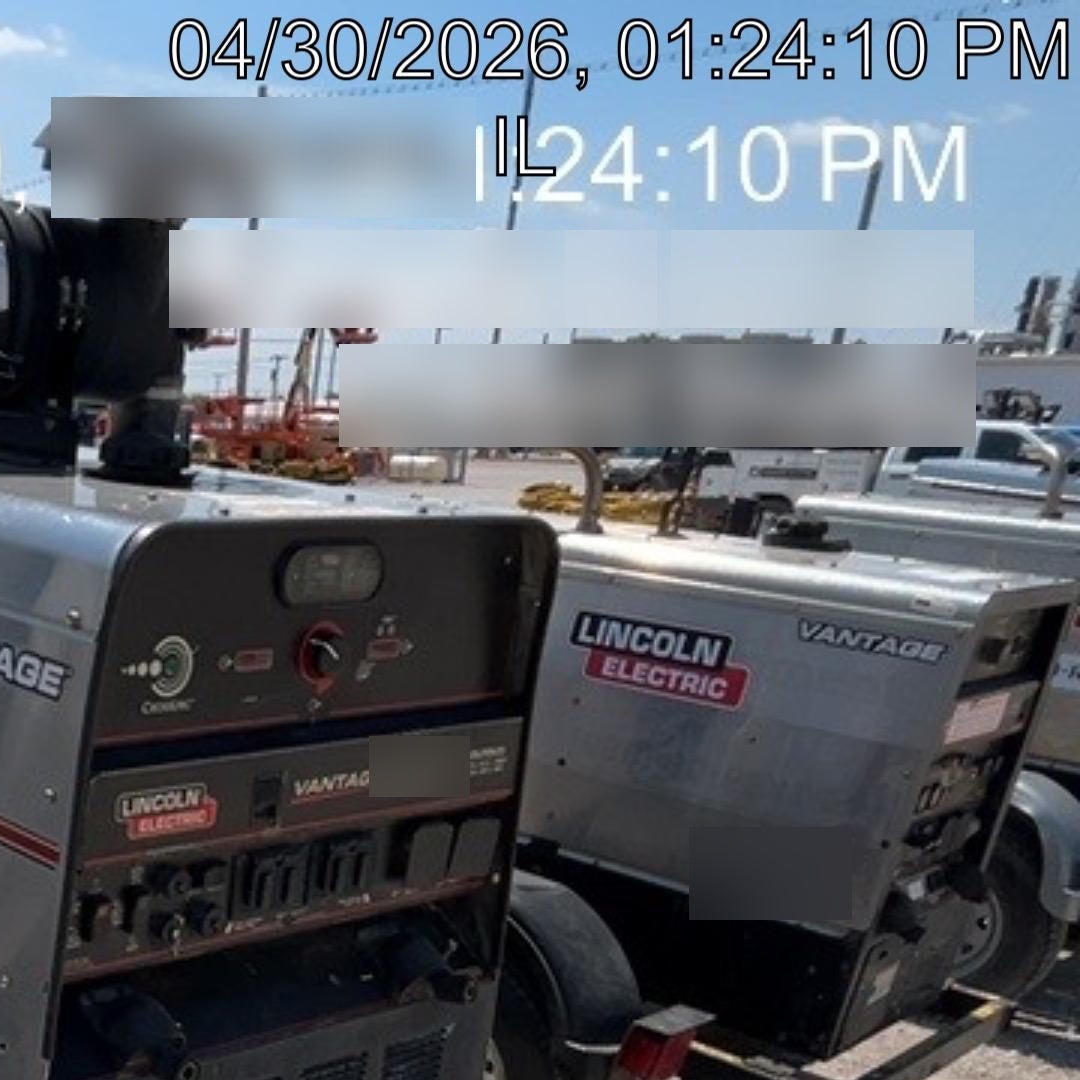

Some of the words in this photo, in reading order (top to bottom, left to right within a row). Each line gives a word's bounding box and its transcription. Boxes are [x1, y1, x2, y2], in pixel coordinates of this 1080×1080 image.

[576, 616, 724, 667] LINCOLN
[798, 618, 949, 663] VANTAGE
[601, 654, 728, 699] ELECTRIC
[292, 769, 370, 797] VANTAG
[121, 787, 201, 818] LINCOLN
[137, 808, 209, 833] ELECTRIC
